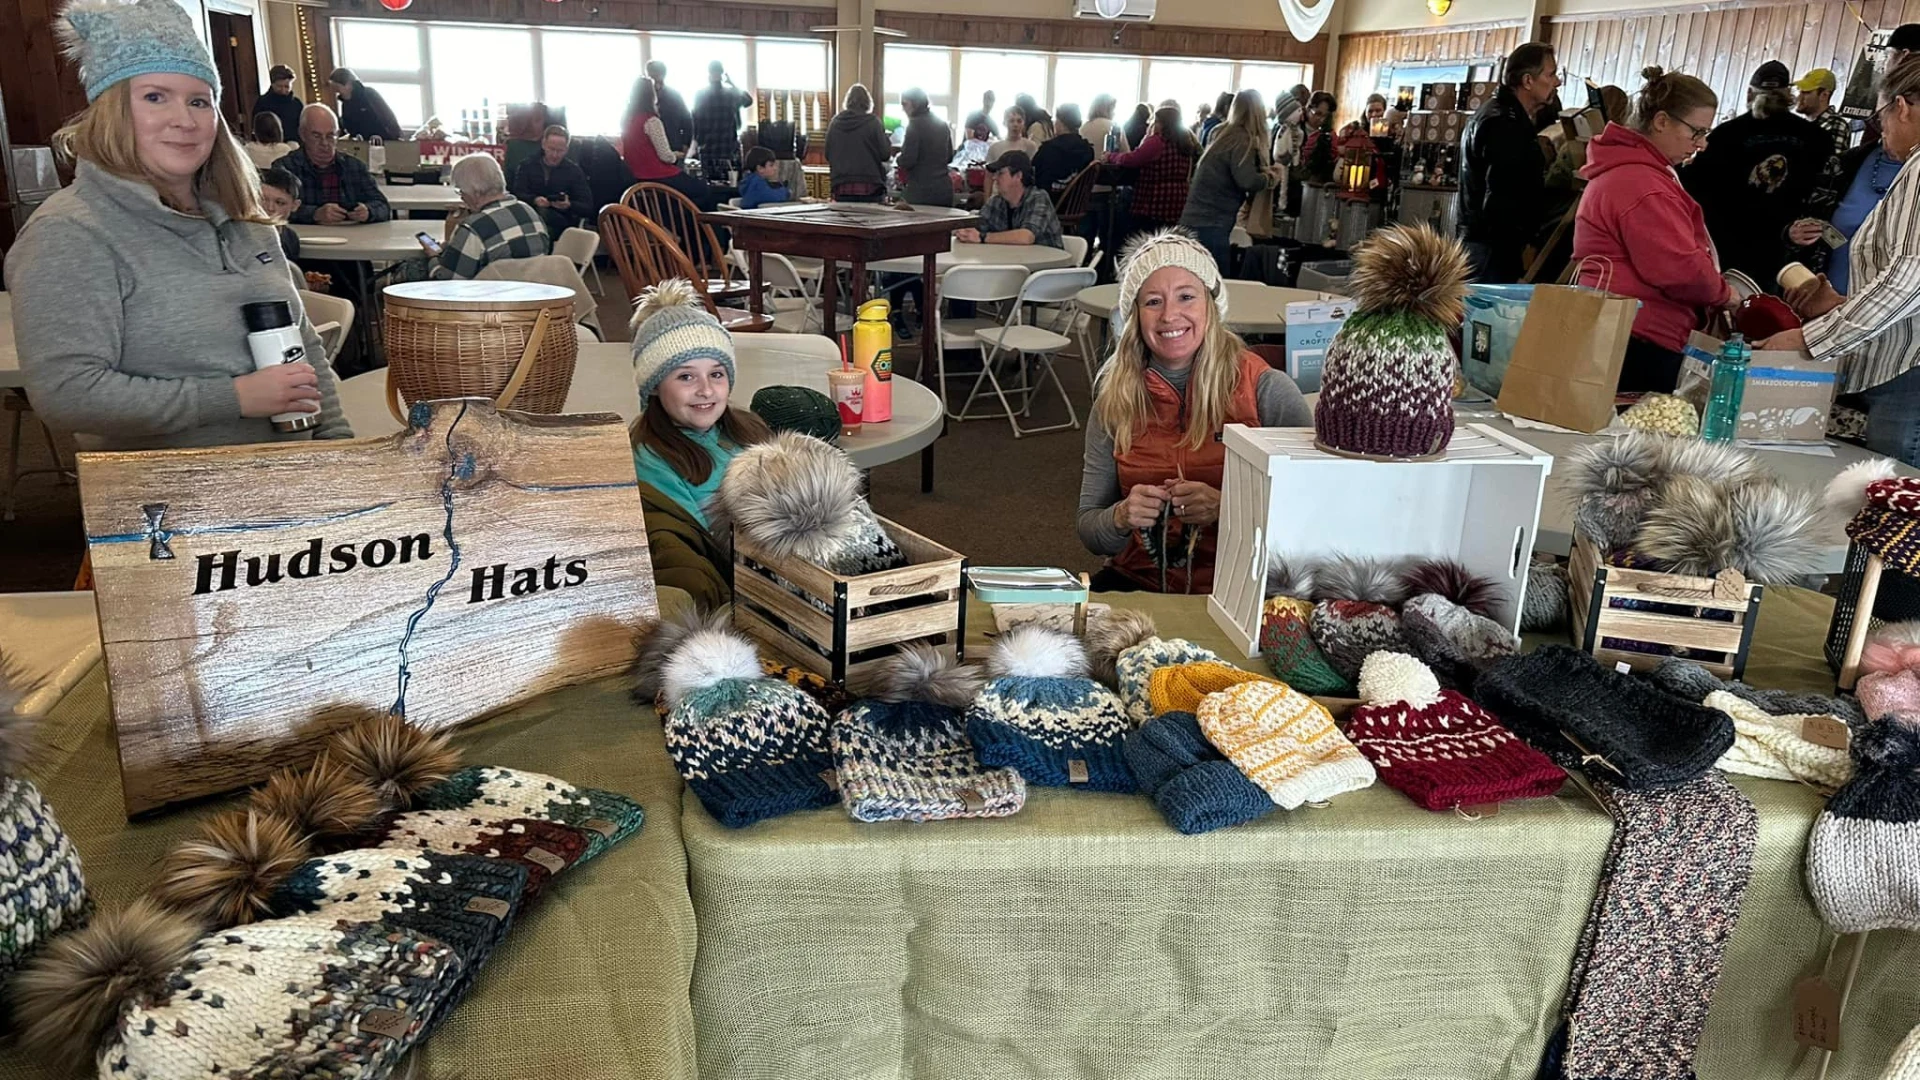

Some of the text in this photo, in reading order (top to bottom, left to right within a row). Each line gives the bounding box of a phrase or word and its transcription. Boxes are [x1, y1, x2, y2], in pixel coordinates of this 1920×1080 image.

[433, 145, 505, 160] WINR
[192, 533, 589, 604] Hudson Hats
